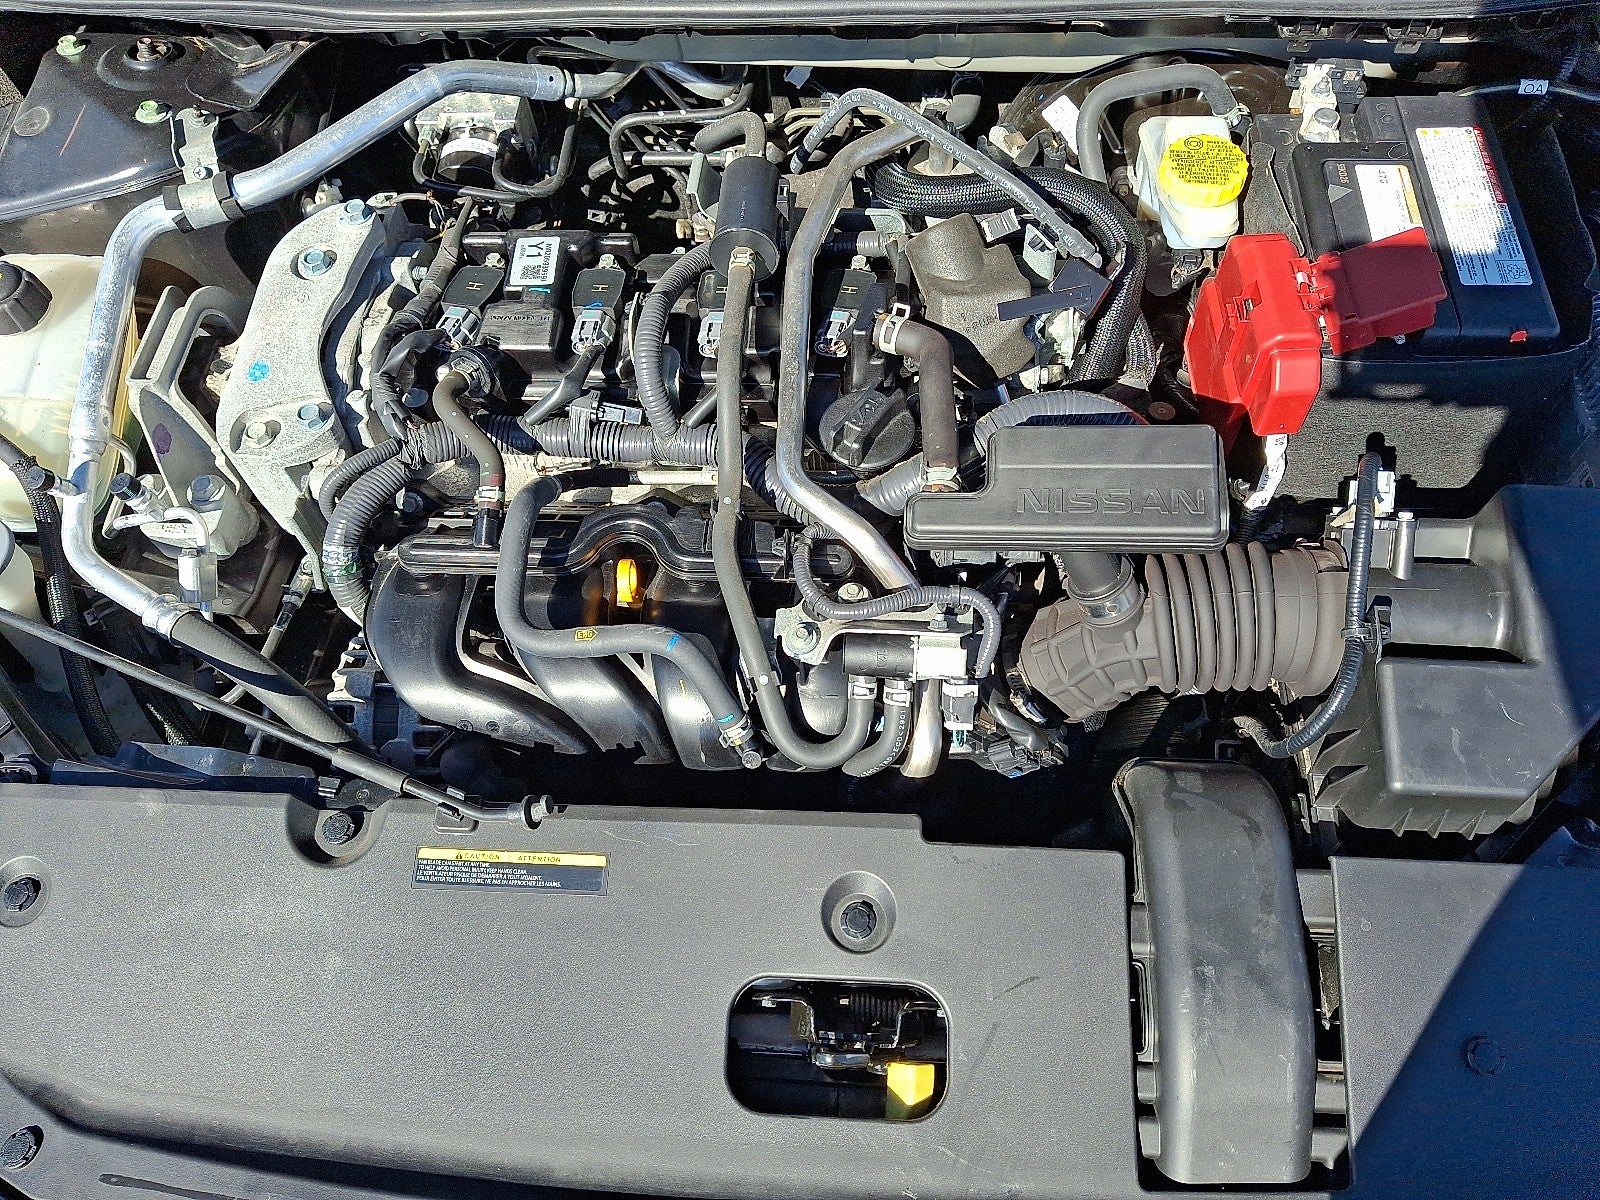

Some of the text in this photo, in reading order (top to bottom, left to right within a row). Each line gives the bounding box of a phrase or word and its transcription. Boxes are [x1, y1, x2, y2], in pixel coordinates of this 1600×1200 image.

[466, 282, 484, 290] H
[840, 286, 858, 294] H
[1016, 487, 1206, 514] NISSAN
